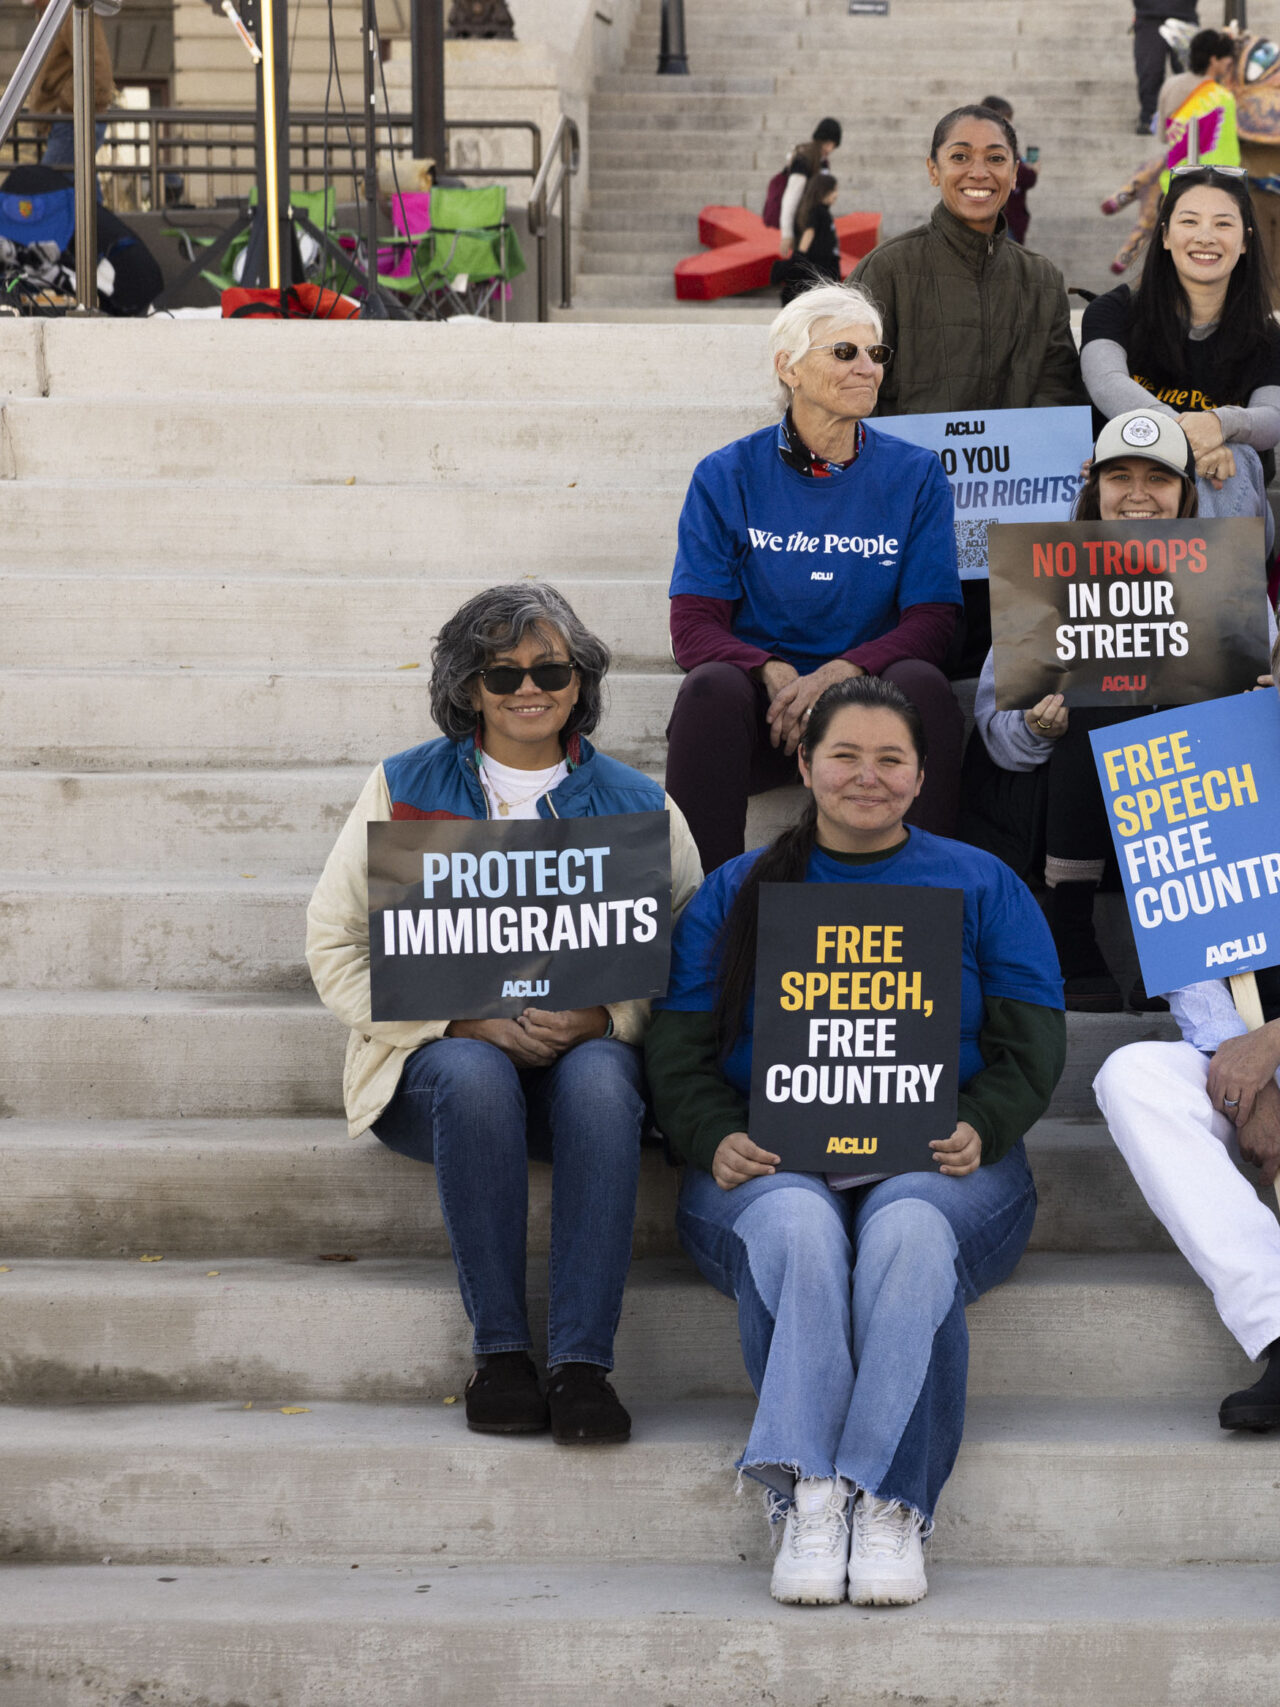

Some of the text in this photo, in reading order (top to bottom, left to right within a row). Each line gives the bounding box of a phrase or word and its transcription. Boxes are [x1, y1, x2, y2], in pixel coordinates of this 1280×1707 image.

[945, 420, 985, 436] ACLU
[932, 445, 1010, 476] O YOU
[747, 527, 899, 558] We the People
[1033, 538, 1208, 578] NO TROOPS
[811, 571, 834, 581] ACLU
[1068, 580, 1175, 618] IN OUR
[1055, 621, 1189, 660] STREETS
[1101, 675, 1147, 692] ACLU
[1103, 730, 1196, 792] FREE
[1113, 763, 1259, 837] SPEECH
[1123, 821, 1217, 885] FREE
[423, 847, 610, 899] PROTECT
[383, 897, 658, 956] IMMIGRANTS
[816, 925, 903, 964] FREE
[1205, 932, 1267, 967] ACLU
[501, 979, 550, 998] ACLU
[780, 971, 933, 1018] SPEECH,
[808, 1018, 896, 1057] FREE
[765, 1064, 944, 1104] COUNTRY
[826, 1137, 877, 1154] ACLU
